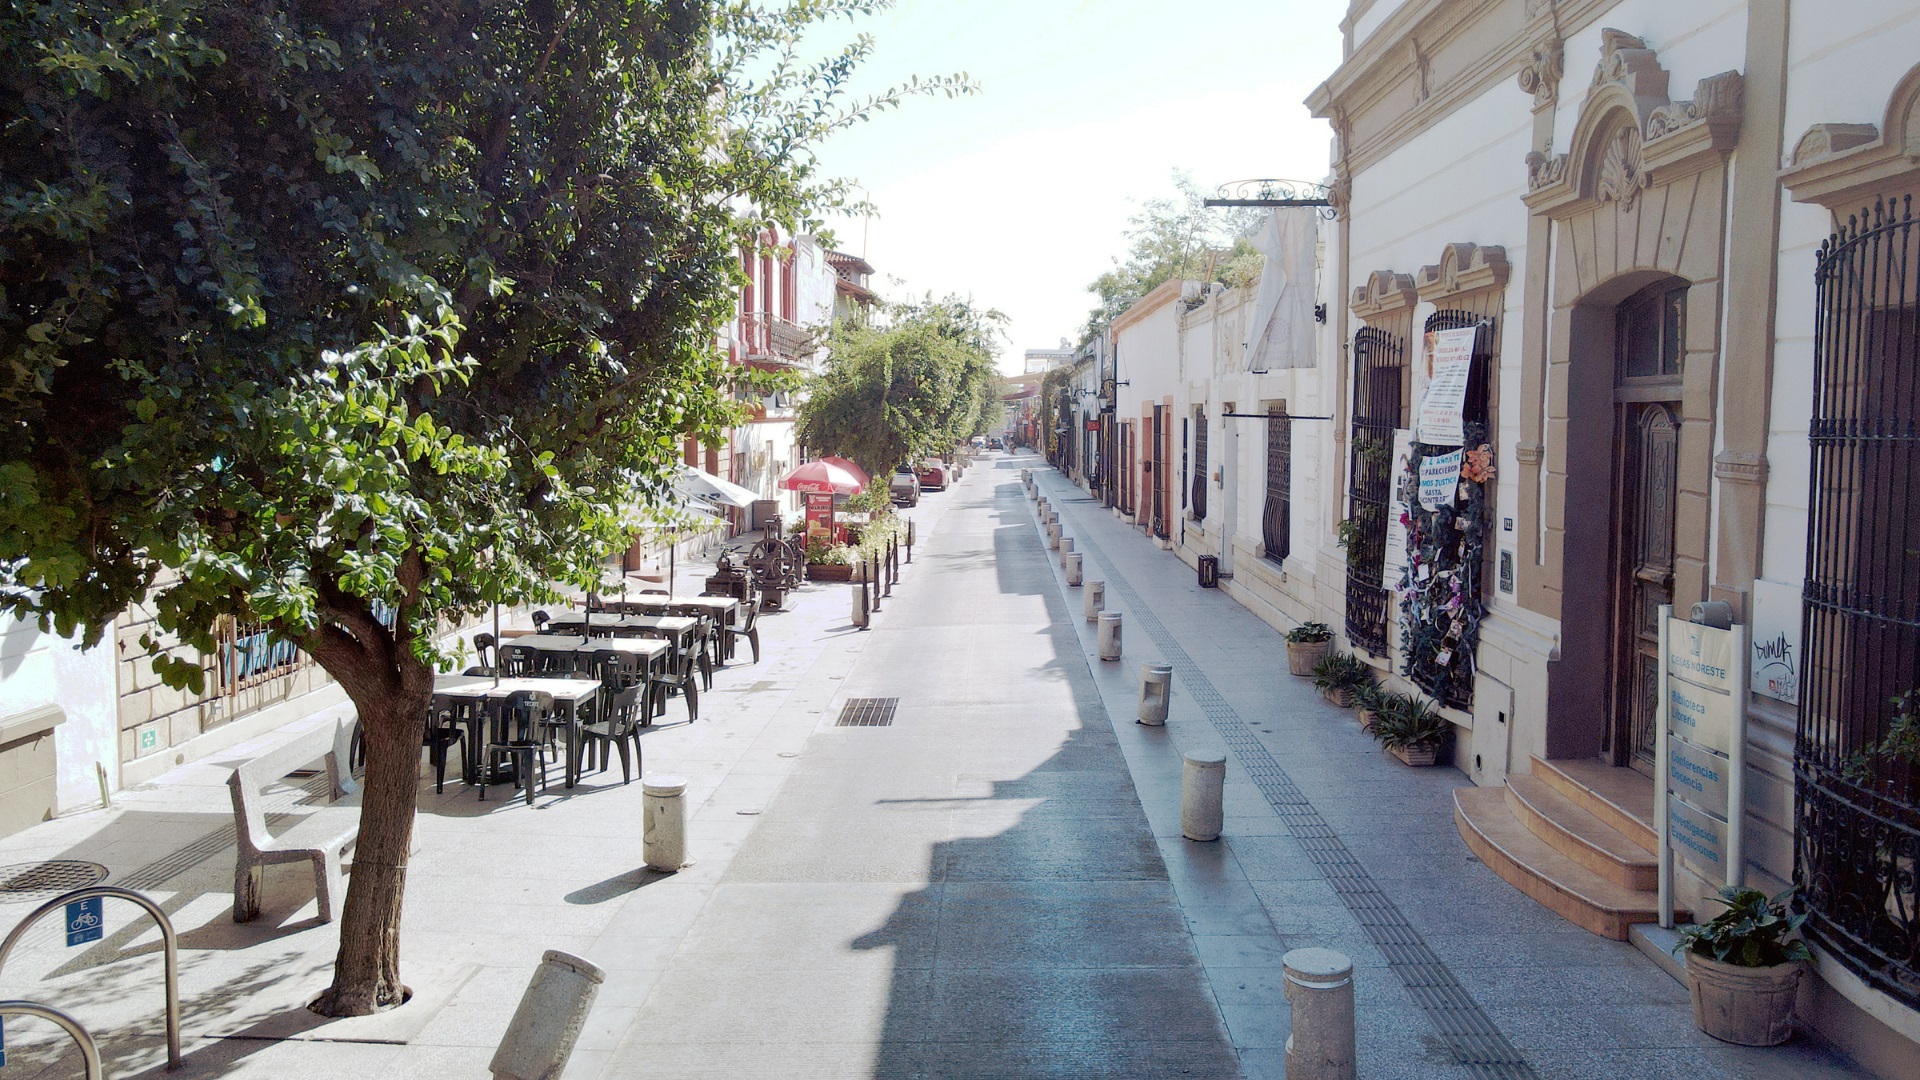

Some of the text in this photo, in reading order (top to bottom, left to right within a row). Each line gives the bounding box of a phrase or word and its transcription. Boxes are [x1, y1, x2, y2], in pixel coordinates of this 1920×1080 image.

[1691, 661, 1726, 680] NORESTE
[1672, 690, 1706, 714] Biblioteca
[1671, 750, 1719, 782] Conferencias
[1671, 766, 1703, 792] Docencia
[1671, 825, 1719, 862] Exposiciones
[80, 901, 89, 911] E
